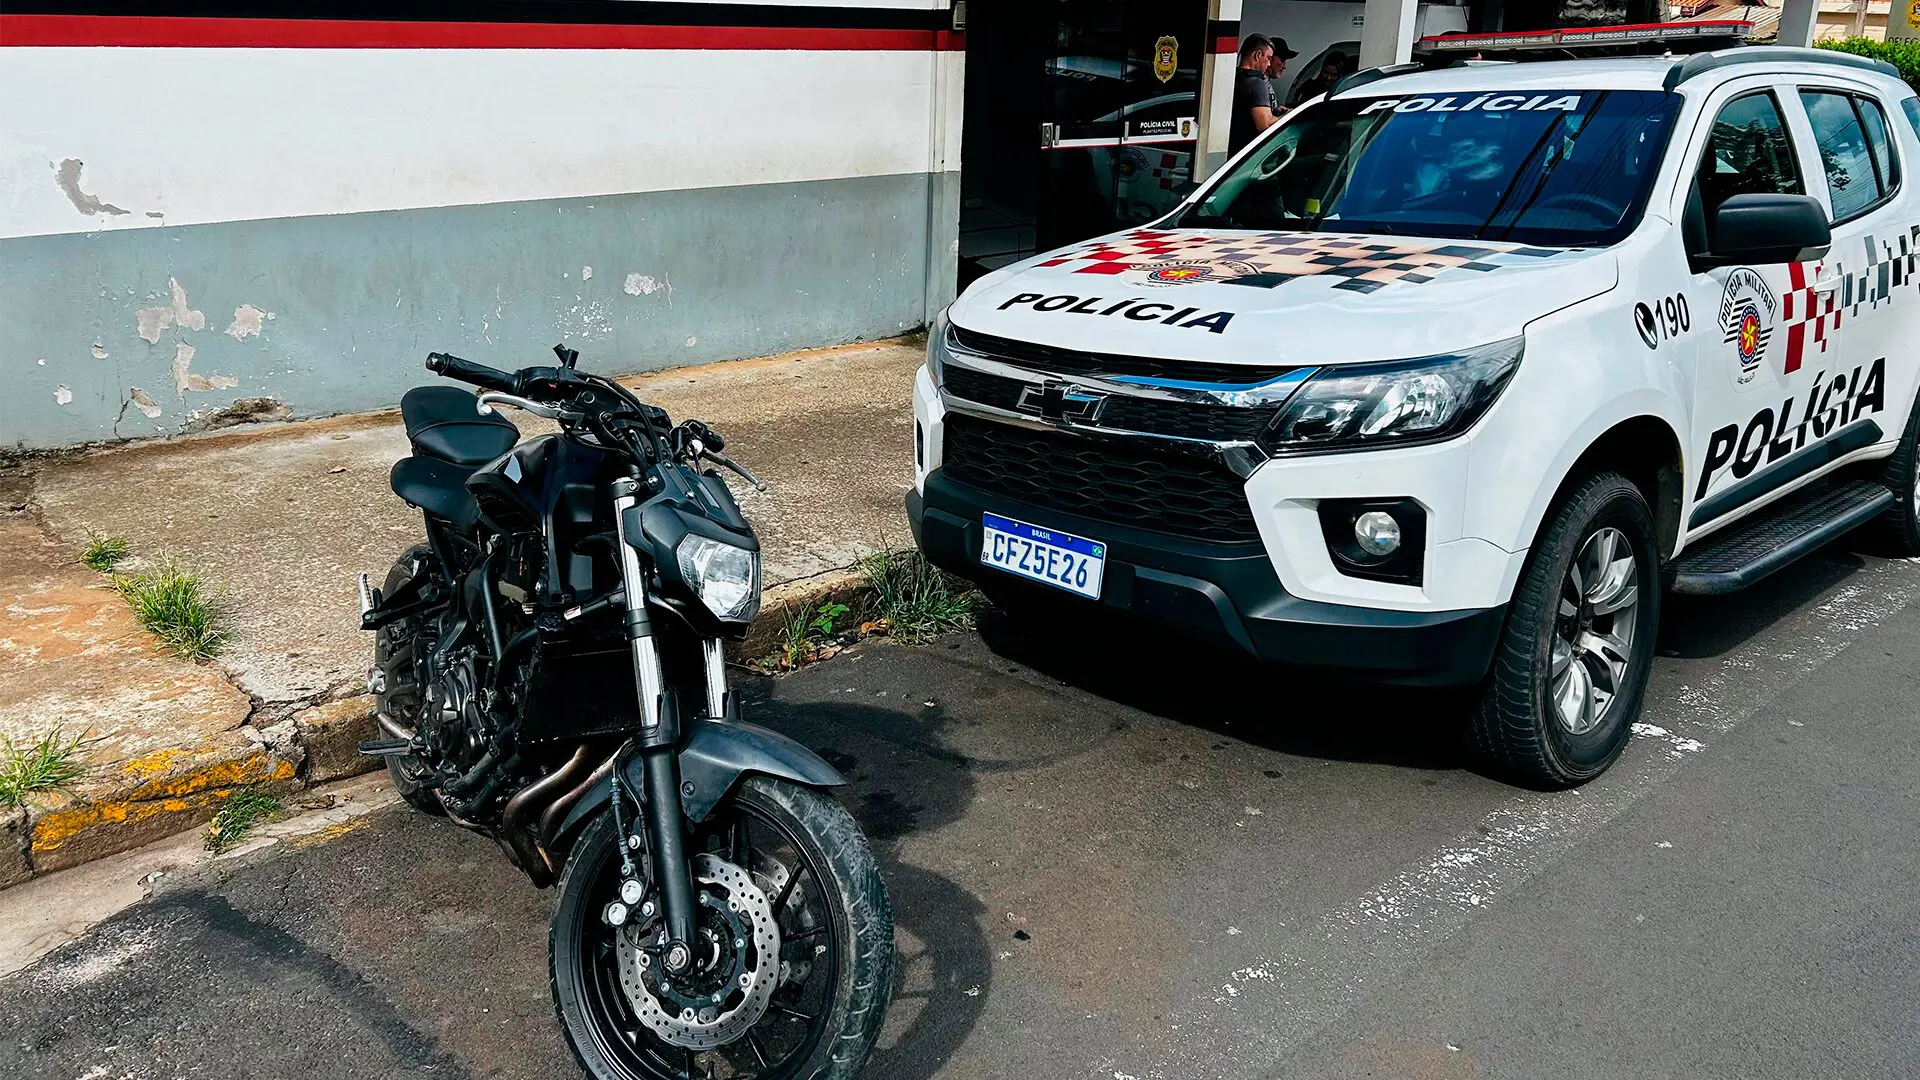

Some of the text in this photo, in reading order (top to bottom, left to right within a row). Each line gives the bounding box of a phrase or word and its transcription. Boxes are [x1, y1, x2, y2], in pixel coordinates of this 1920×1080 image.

[1140, 120, 1176, 129] POLÍCIA CIVIL
[1358, 93, 1581, 115] POLÍCIA
[996, 293, 1236, 334] POLÍCIA
[1744, 272, 1773, 314] MILITAR
[1655, 292, 1690, 340] 190
[1693, 357, 1885, 502] POLÍCIA
[1031, 529, 1051, 540] BRASIL
[982, 551, 989, 561] BR
[993, 533, 1087, 588] CFZ5E26
